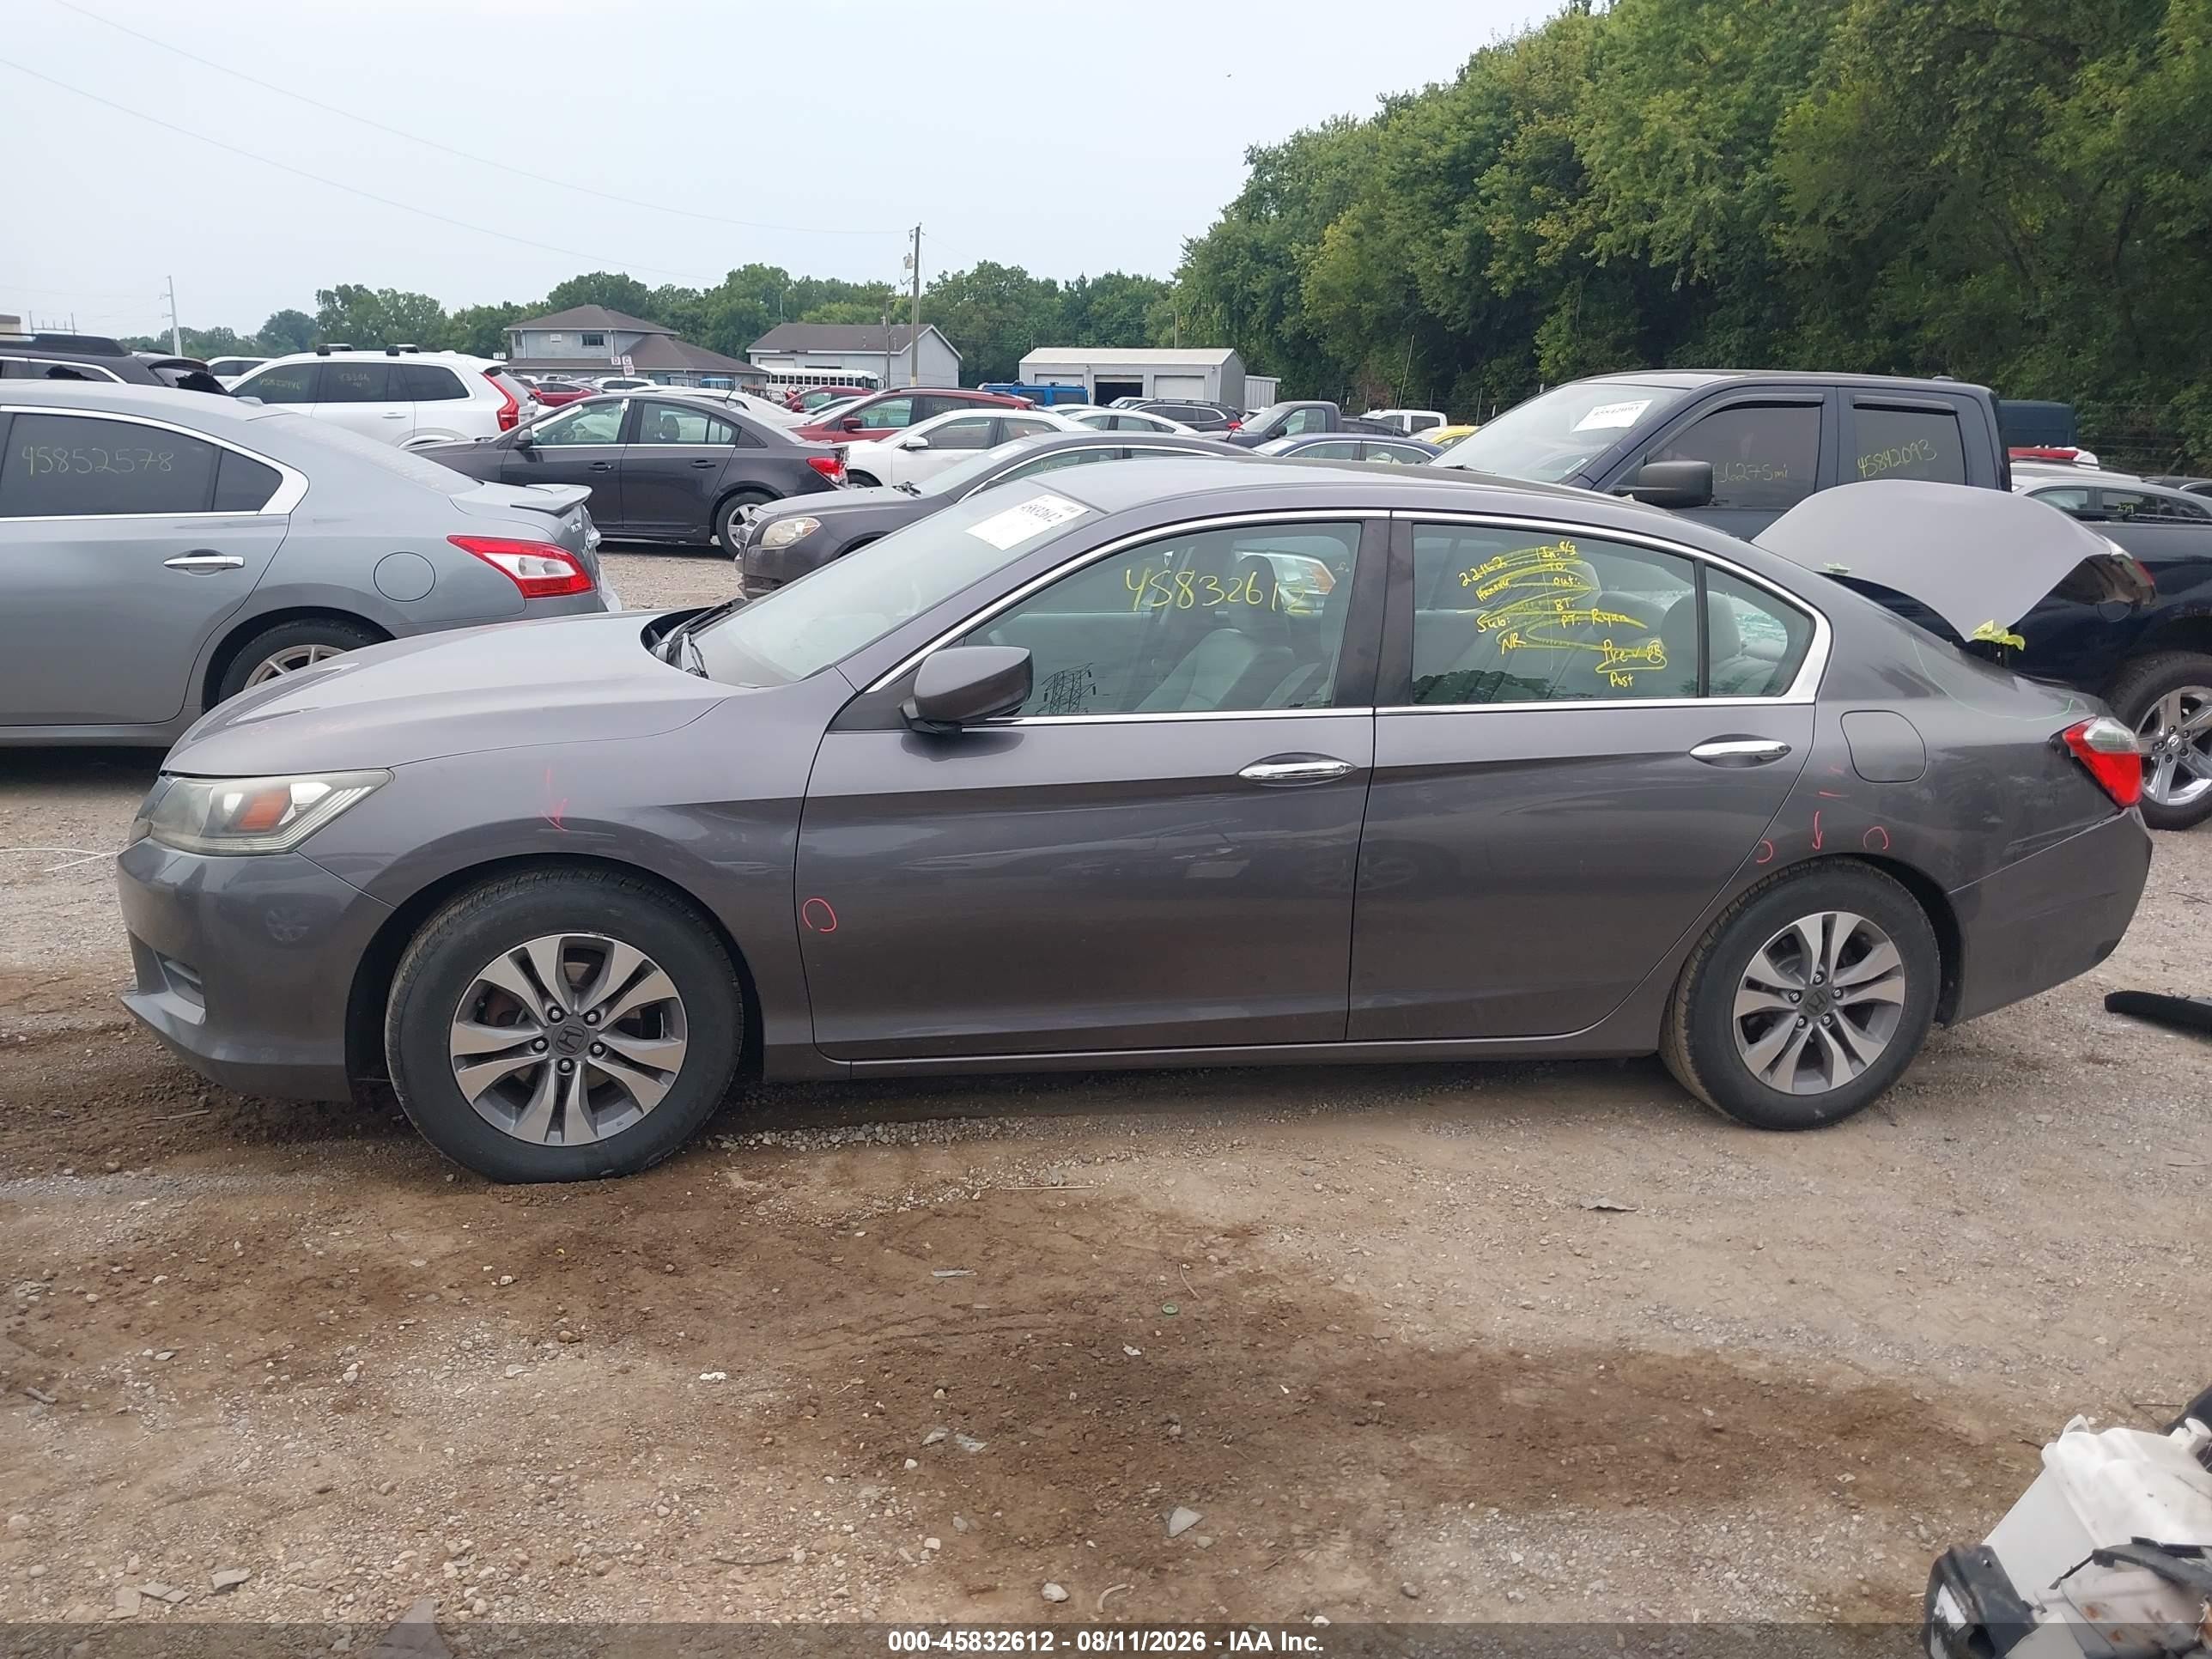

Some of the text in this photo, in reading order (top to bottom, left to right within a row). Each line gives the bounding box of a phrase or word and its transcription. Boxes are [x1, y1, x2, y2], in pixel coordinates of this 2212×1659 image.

[21, 446, 174, 475] 45852578
[1856, 439, 1938, 478] 45842093
[1126, 566, 1313, 614] 45832612
[1591, 608, 1628, 628] Ryan
[1610, 672, 1634, 688] Post
